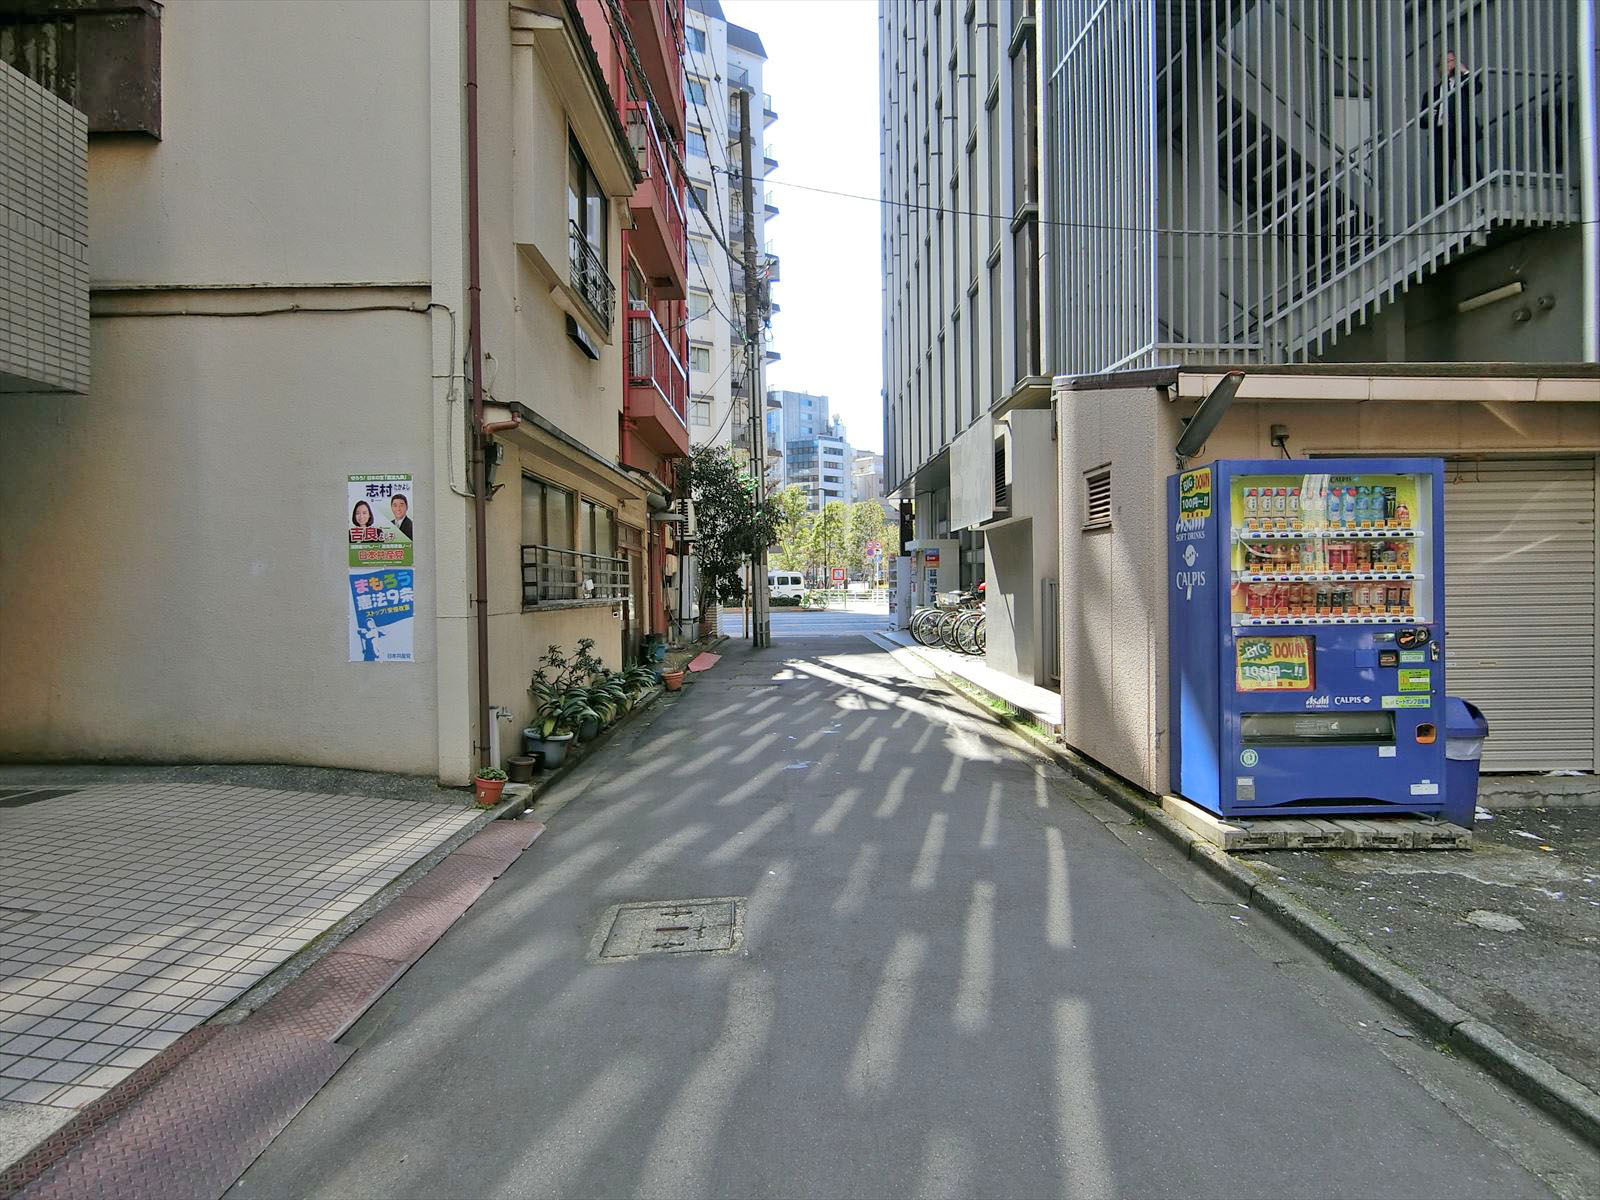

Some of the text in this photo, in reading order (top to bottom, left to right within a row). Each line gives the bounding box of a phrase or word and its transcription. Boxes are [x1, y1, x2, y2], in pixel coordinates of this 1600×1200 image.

[366, 484, 392, 497] 志村
[1183, 472, 1210, 493] BIG DOWN
[1176, 531, 1206, 541] SOFT DRINKS
[354, 571, 411, 593] まもろう
[1176, 571, 1206, 590] CALPIS
[1273, 641, 1308, 659] DOWN
[1306, 695, 1362, 705] Asahi CALPIS
